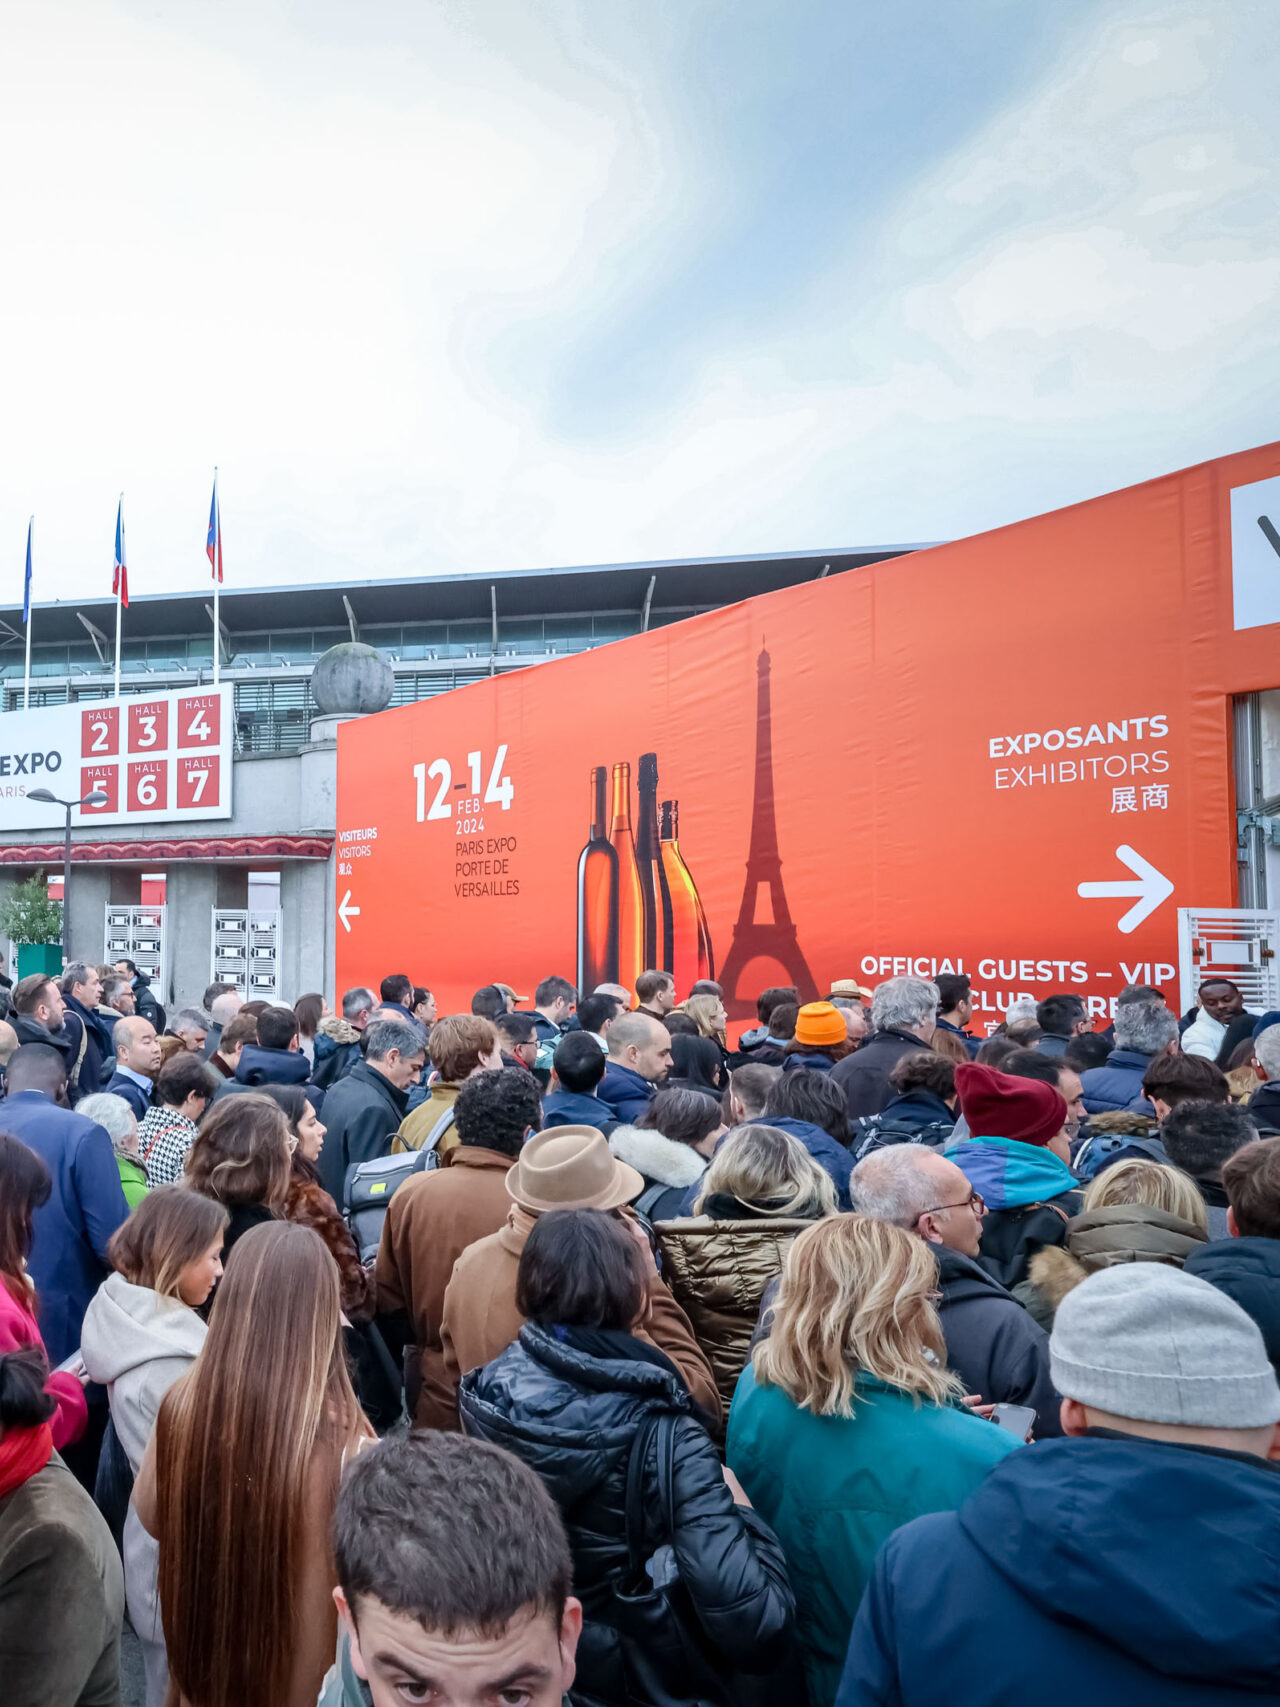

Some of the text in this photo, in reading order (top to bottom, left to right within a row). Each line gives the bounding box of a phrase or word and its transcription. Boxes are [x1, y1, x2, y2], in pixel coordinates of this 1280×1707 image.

[136, 705, 162, 716] HALL
[185, 699, 213, 710] HALL
[88, 711, 113, 720] HALL
[138, 716, 157, 747] 3
[187, 710, 212, 740] 4
[90, 722, 109, 752] 2
[989, 714, 1169, 758] EXPOSANTS
[88, 768, 112, 777] HALL
[134, 763, 161, 773] HALL
[184, 759, 213, 769] HALL
[995, 750, 1170, 790] EXHIBITORS
[137, 774, 158, 806] 6
[187, 770, 209, 802] 7
[458, 798, 484, 815] FEB.
[1110, 782, 1170, 814] 展商
[338, 827, 378, 843] VISITEURS
[456, 818, 485, 835] 2024
[338, 845, 372, 859] VISITORS
[456, 836, 517, 856] PARIS EXPO
[455, 859, 509, 877] PORTE DE
[454, 880, 520, 898] VERSAILLES
[860, 956, 972, 978] OFFICIAL
[978, 958, 1088, 983] GUESTS
[1119, 962, 1176, 986] VIP
